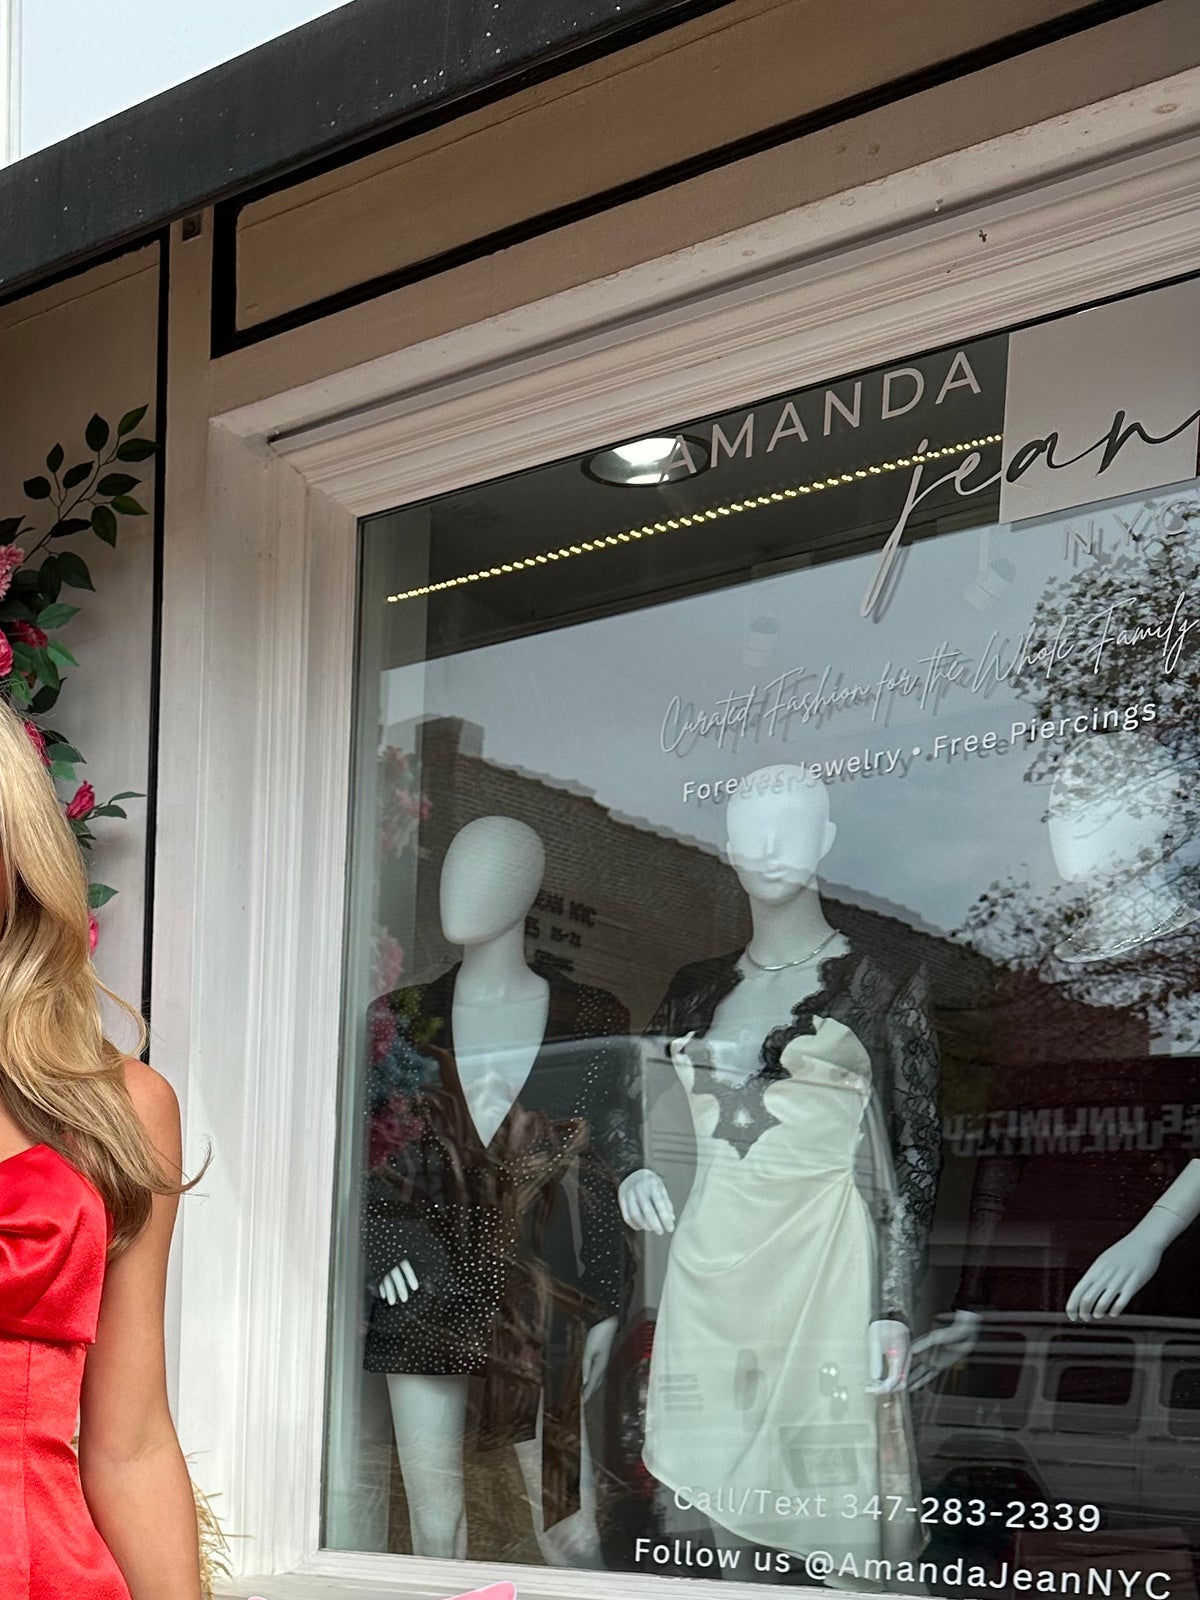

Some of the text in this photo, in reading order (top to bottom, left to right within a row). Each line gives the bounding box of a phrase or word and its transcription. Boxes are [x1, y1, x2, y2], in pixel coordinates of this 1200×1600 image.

[659, 351, 982, 485] AMANDA
[860, 409, 1200, 618] jean
[1063, 502, 1190, 561] NYC
[661, 592, 1200, 752] Curated Fashion for the Whole Family
[799, 747, 902, 782] Jewelry
[933, 731, 999, 758] Free
[1011, 702, 1157, 745] Piercings
[674, 1486, 1100, 1533] Call/Text 347-283-2339
[635, 1538, 1172, 1600] Follow us @AmandaJeanNYC
